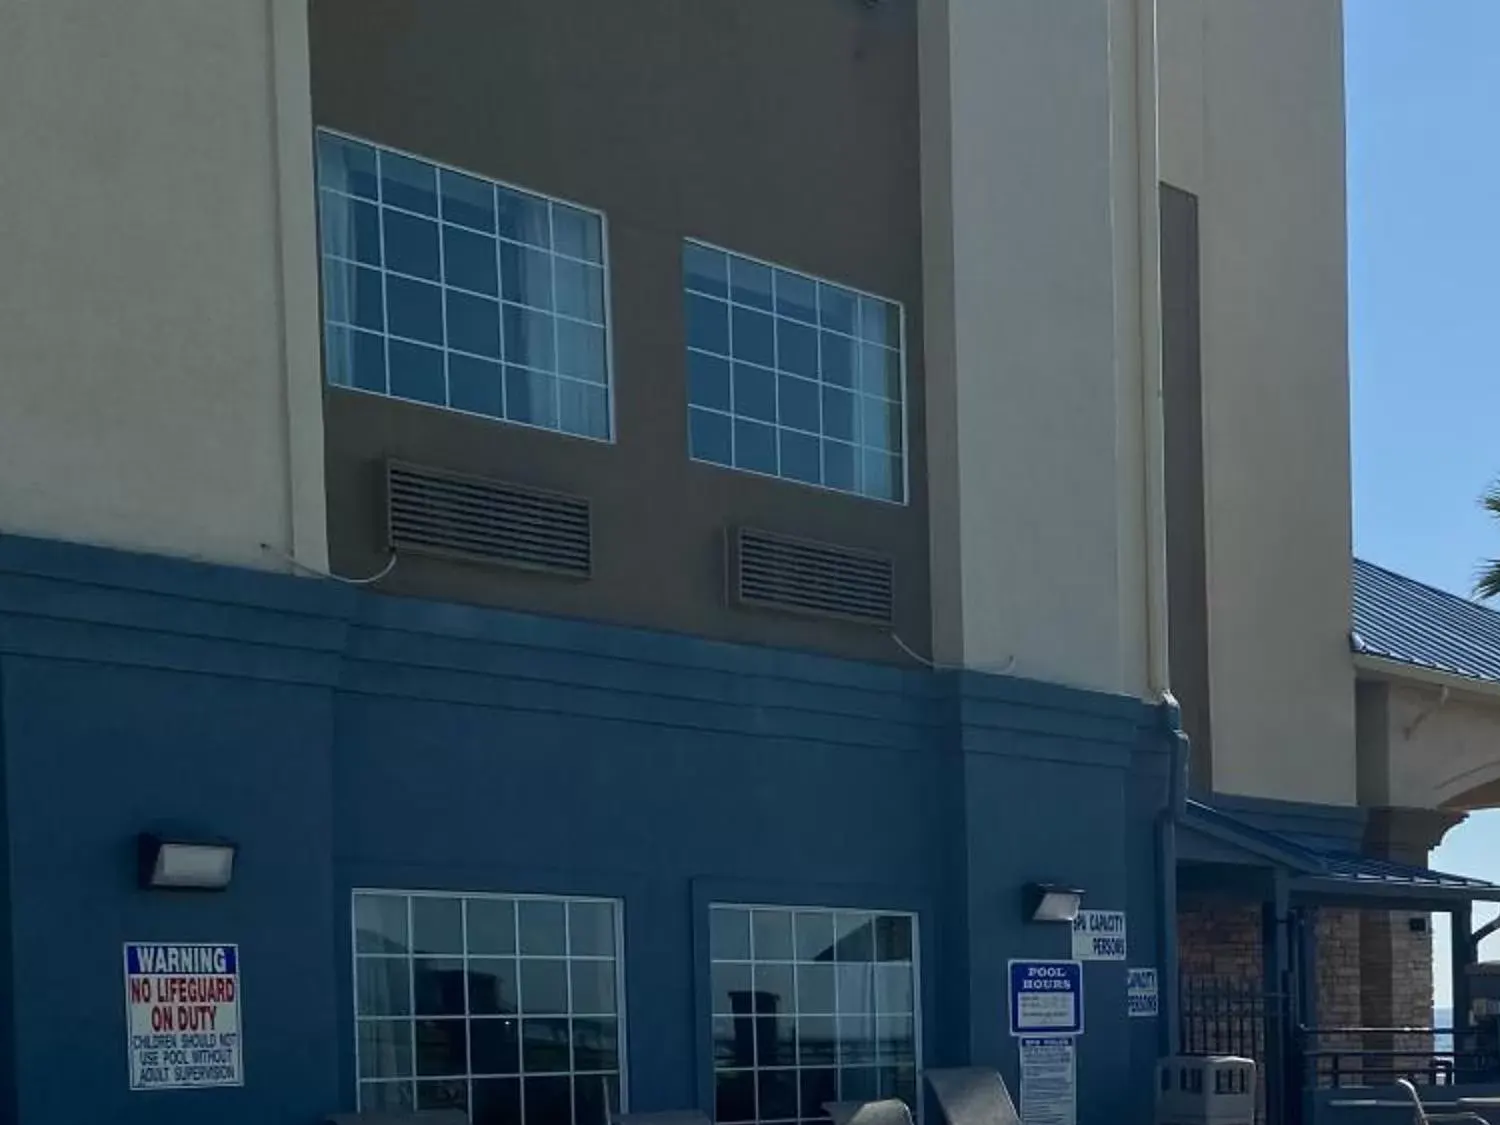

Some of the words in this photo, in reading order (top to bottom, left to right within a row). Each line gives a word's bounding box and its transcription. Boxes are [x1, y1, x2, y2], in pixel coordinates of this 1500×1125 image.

[1090, 913, 1123, 932] CAPACITY
[1093, 937, 1125, 955] PERSONS
[137, 947, 227, 973] WARNING
[1027, 967, 1066, 977] POOL
[131, 978, 151, 1004] NO
[157, 977, 235, 1003] LIFEGUARD
[1023, 979, 1071, 990] HOURS
[151, 1005, 174, 1032] ON
[178, 1005, 217, 1031] DUTY
[132, 1034, 177, 1049] CHILDREN
[181, 1033, 216, 1048] SHOULD
[219, 1033, 236, 1048] NOT
[141, 1051, 159, 1066] USE
[163, 1049, 189, 1065] POOL
[191, 1049, 233, 1064] WITHOUT
[141, 1067, 168, 1082] ADULT
[174, 1066, 235, 1081] SUPERVISION
